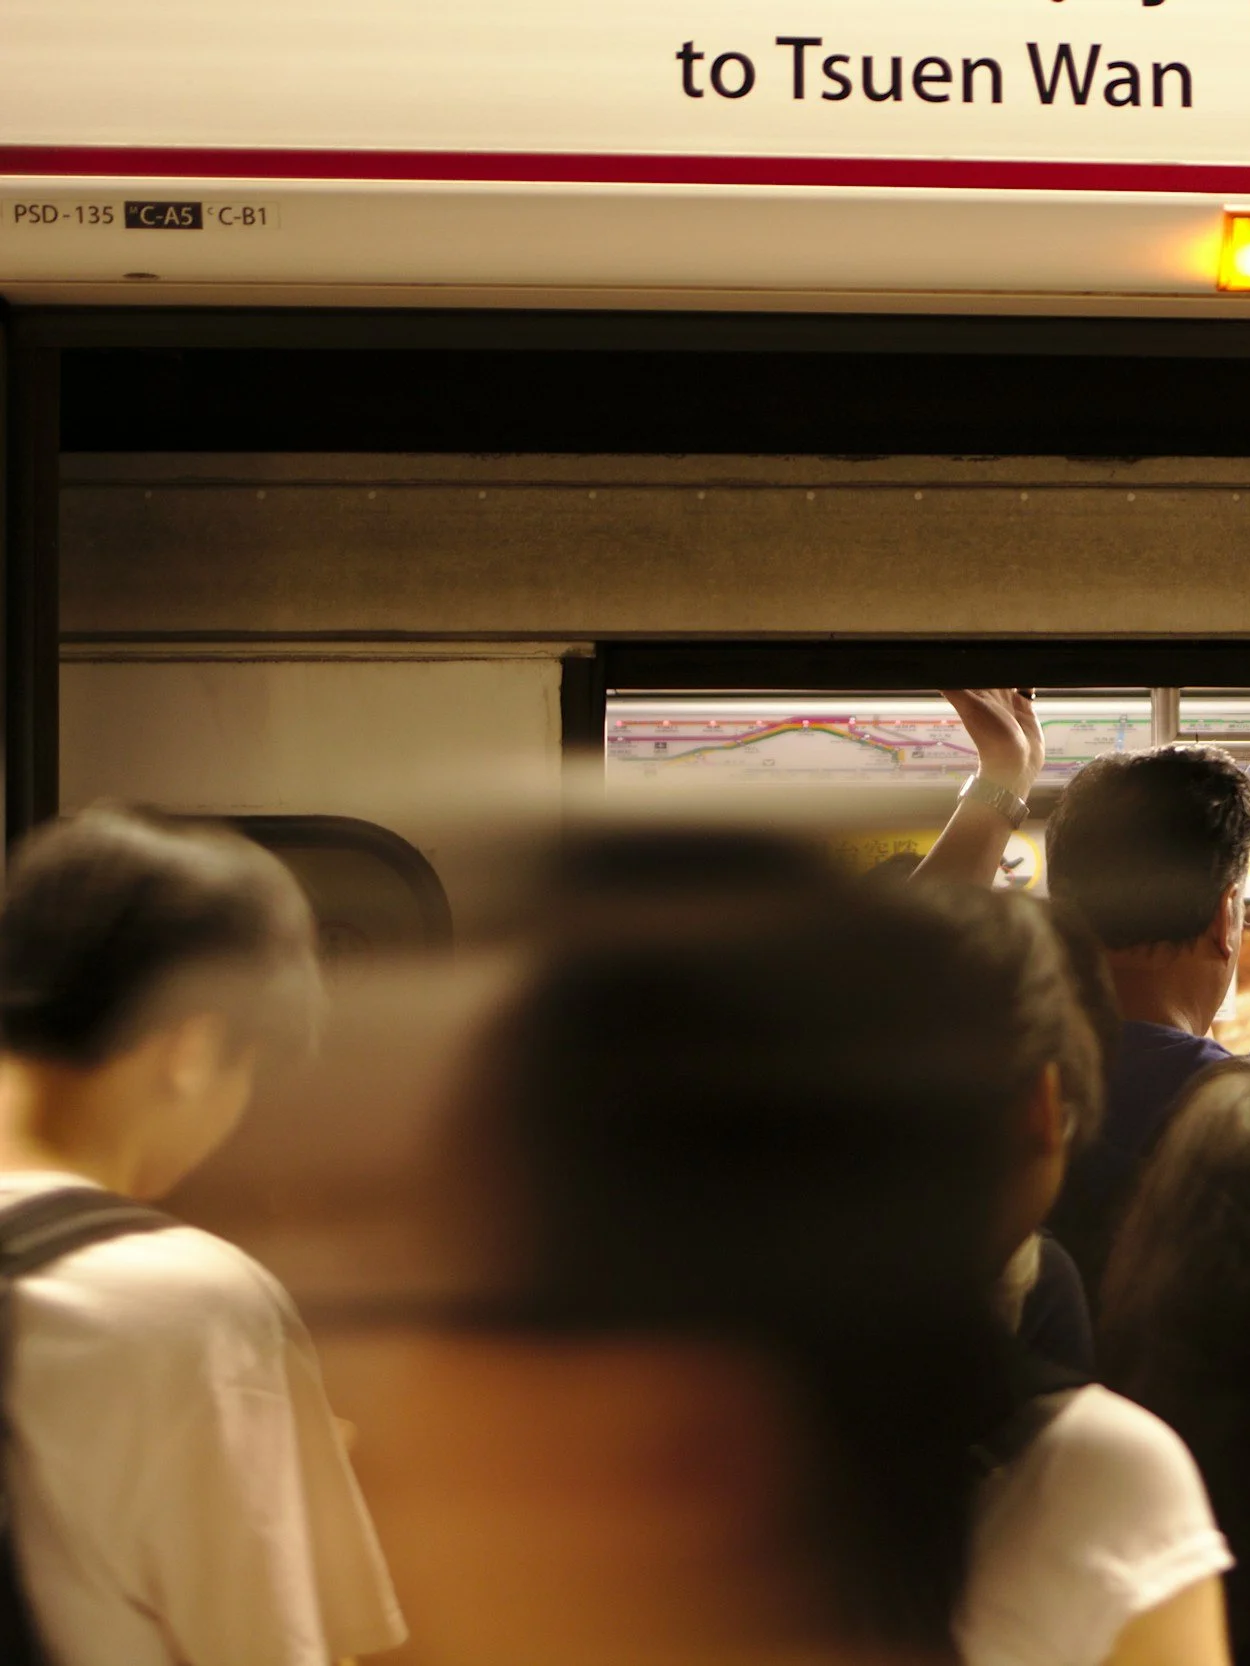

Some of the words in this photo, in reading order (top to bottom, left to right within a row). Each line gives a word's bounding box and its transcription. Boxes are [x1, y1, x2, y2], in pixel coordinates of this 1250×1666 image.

[676, 41, 756, 98] to
[776, 37, 1003, 103] Tsuen
[1027, 42, 1193, 107] Wan
[14, 203, 115, 225] PSD-135
